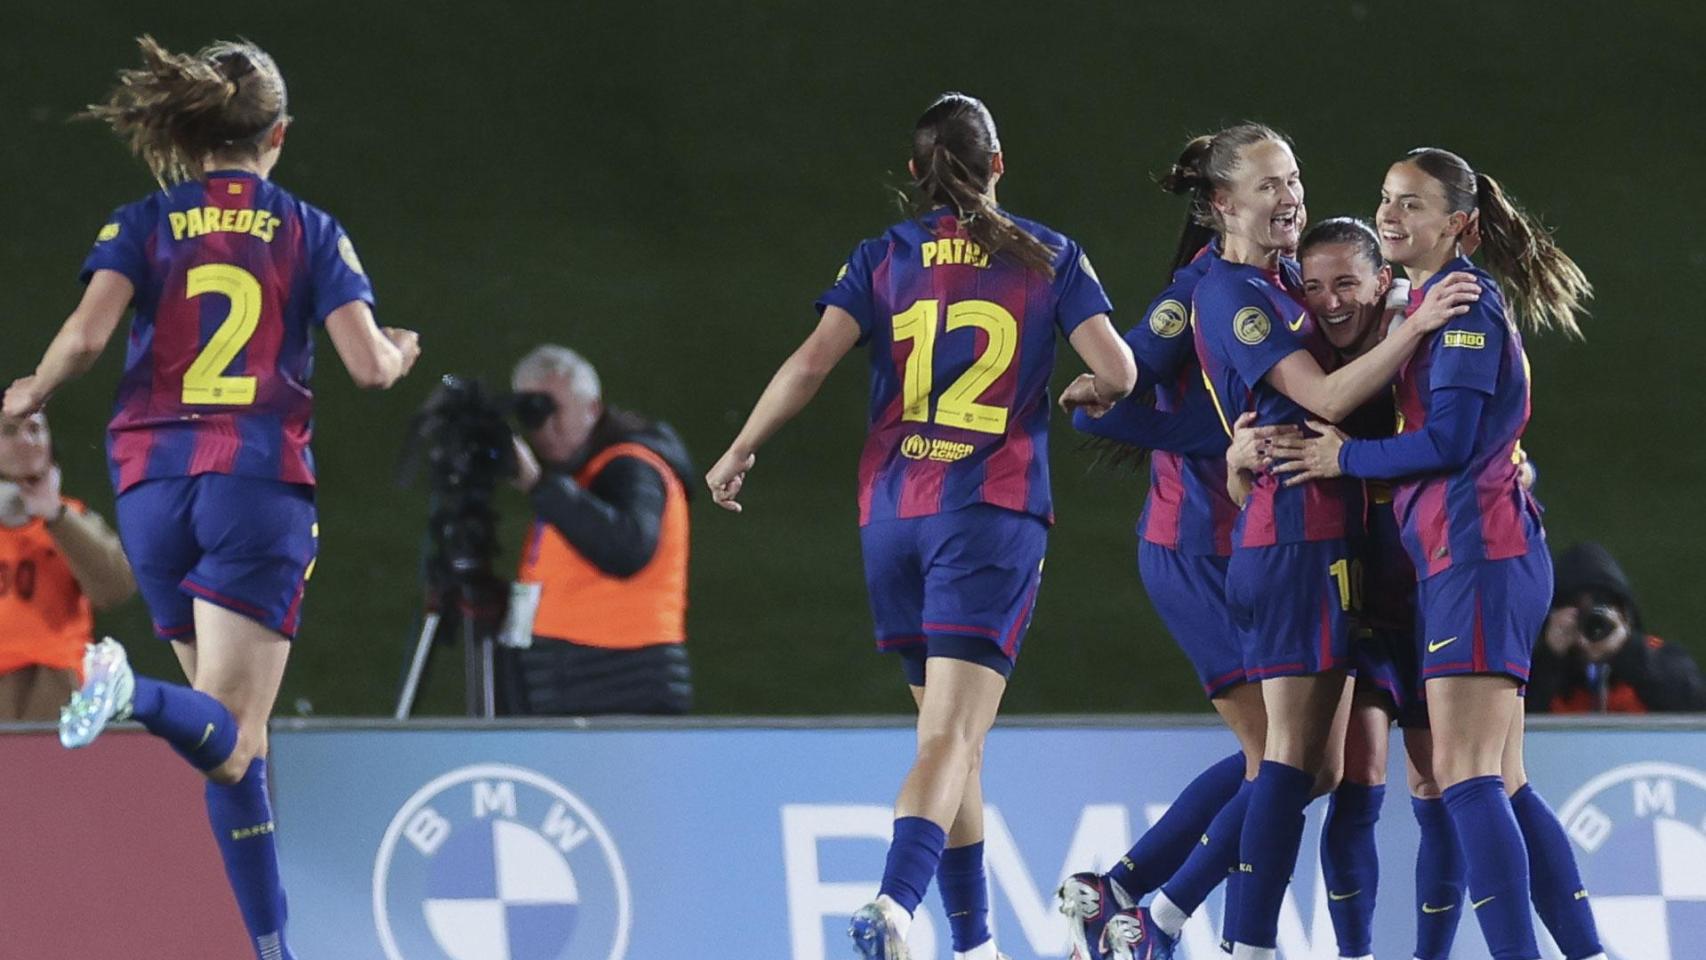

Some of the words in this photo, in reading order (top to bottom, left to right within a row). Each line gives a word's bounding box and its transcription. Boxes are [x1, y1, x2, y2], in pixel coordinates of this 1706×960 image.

[168, 206, 281, 243] PAREDES
[181, 263, 262, 405] 2
[892, 299, 1018, 434] 12
[929, 448, 968, 461] ACNU
[932, 439, 974, 454] UNHCR
[402, 780, 590, 856] BMW
[1567, 779, 1706, 855] BM
